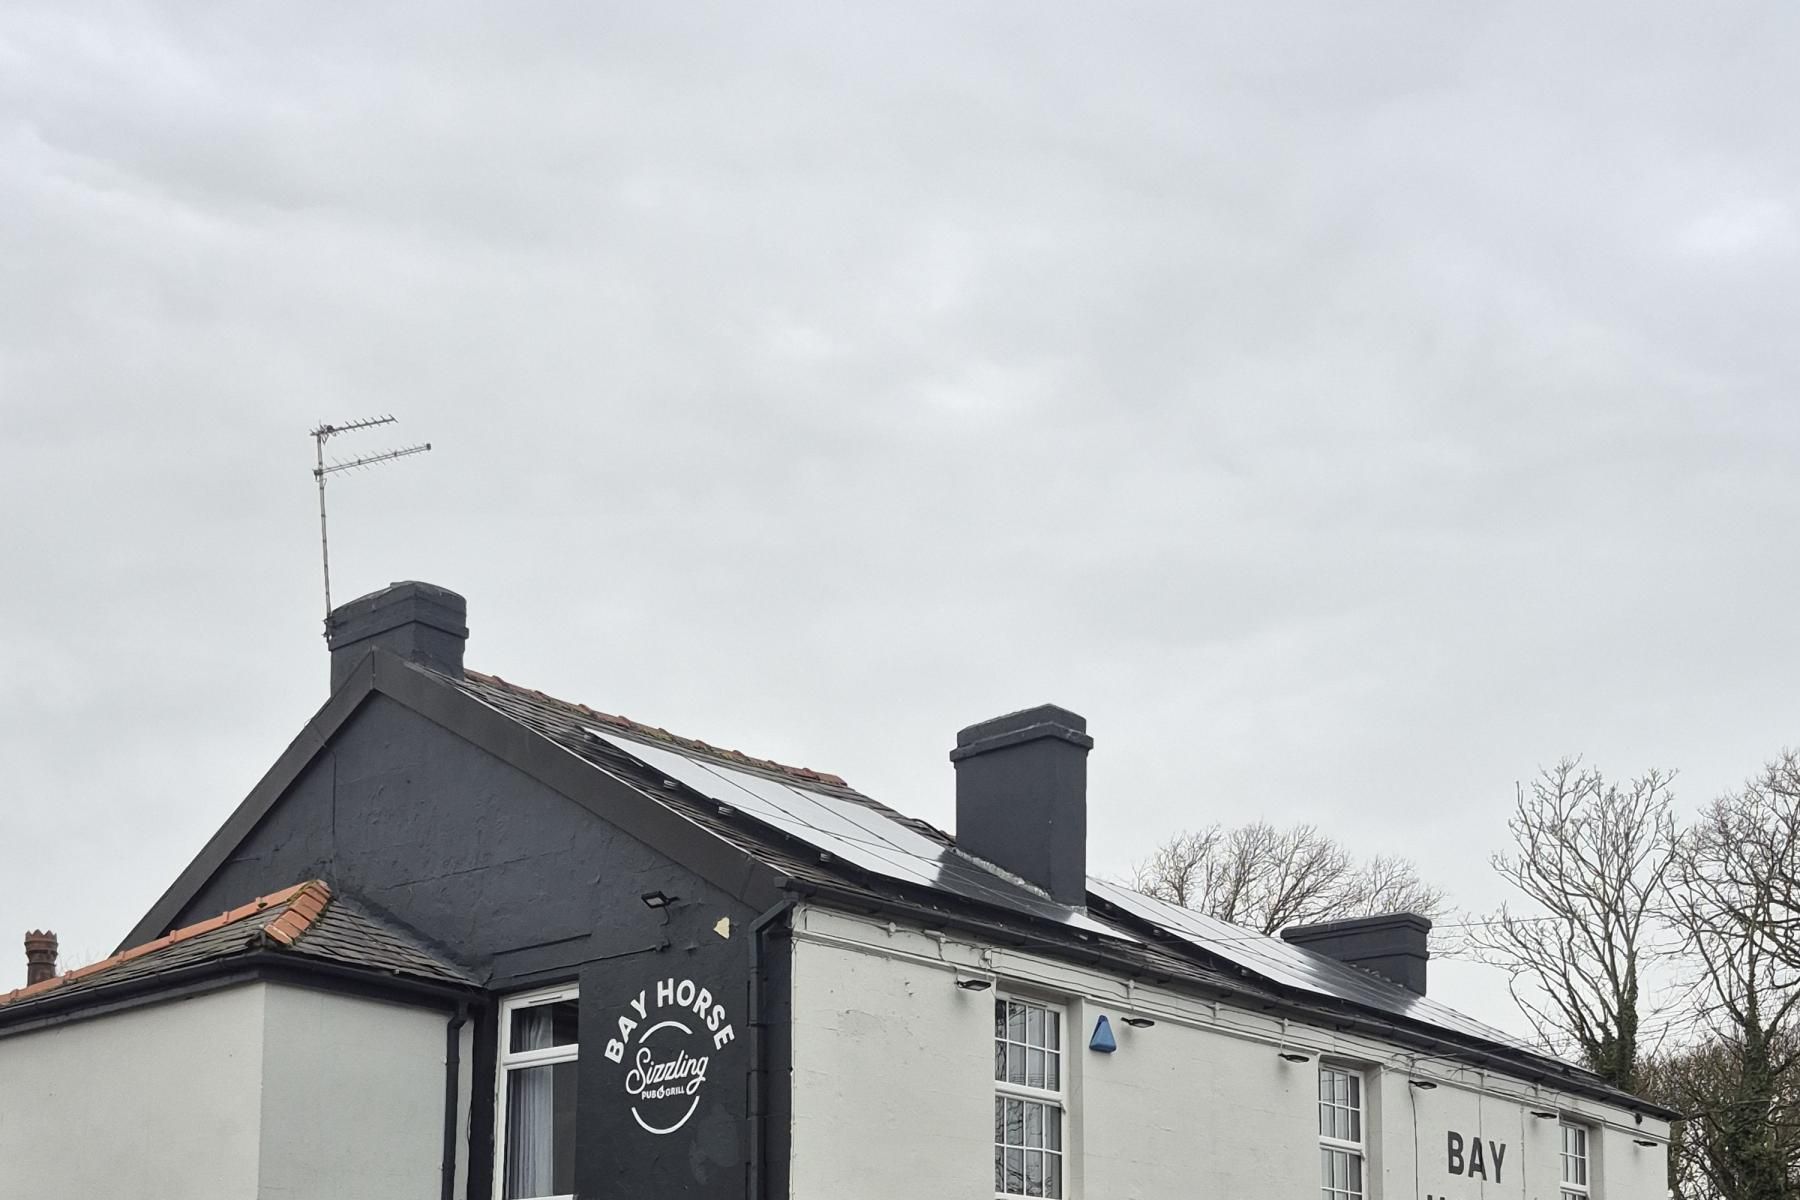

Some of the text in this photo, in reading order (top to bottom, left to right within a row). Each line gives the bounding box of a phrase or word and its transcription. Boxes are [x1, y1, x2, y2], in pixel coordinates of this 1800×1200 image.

[604, 978, 735, 1064] BAY HORSE
[626, 1047, 709, 1095] Sizzling
[641, 1090, 657, 1100] PUB
[665, 1086, 685, 1096] GRILL
[1447, 1130, 1507, 1184] BAY
